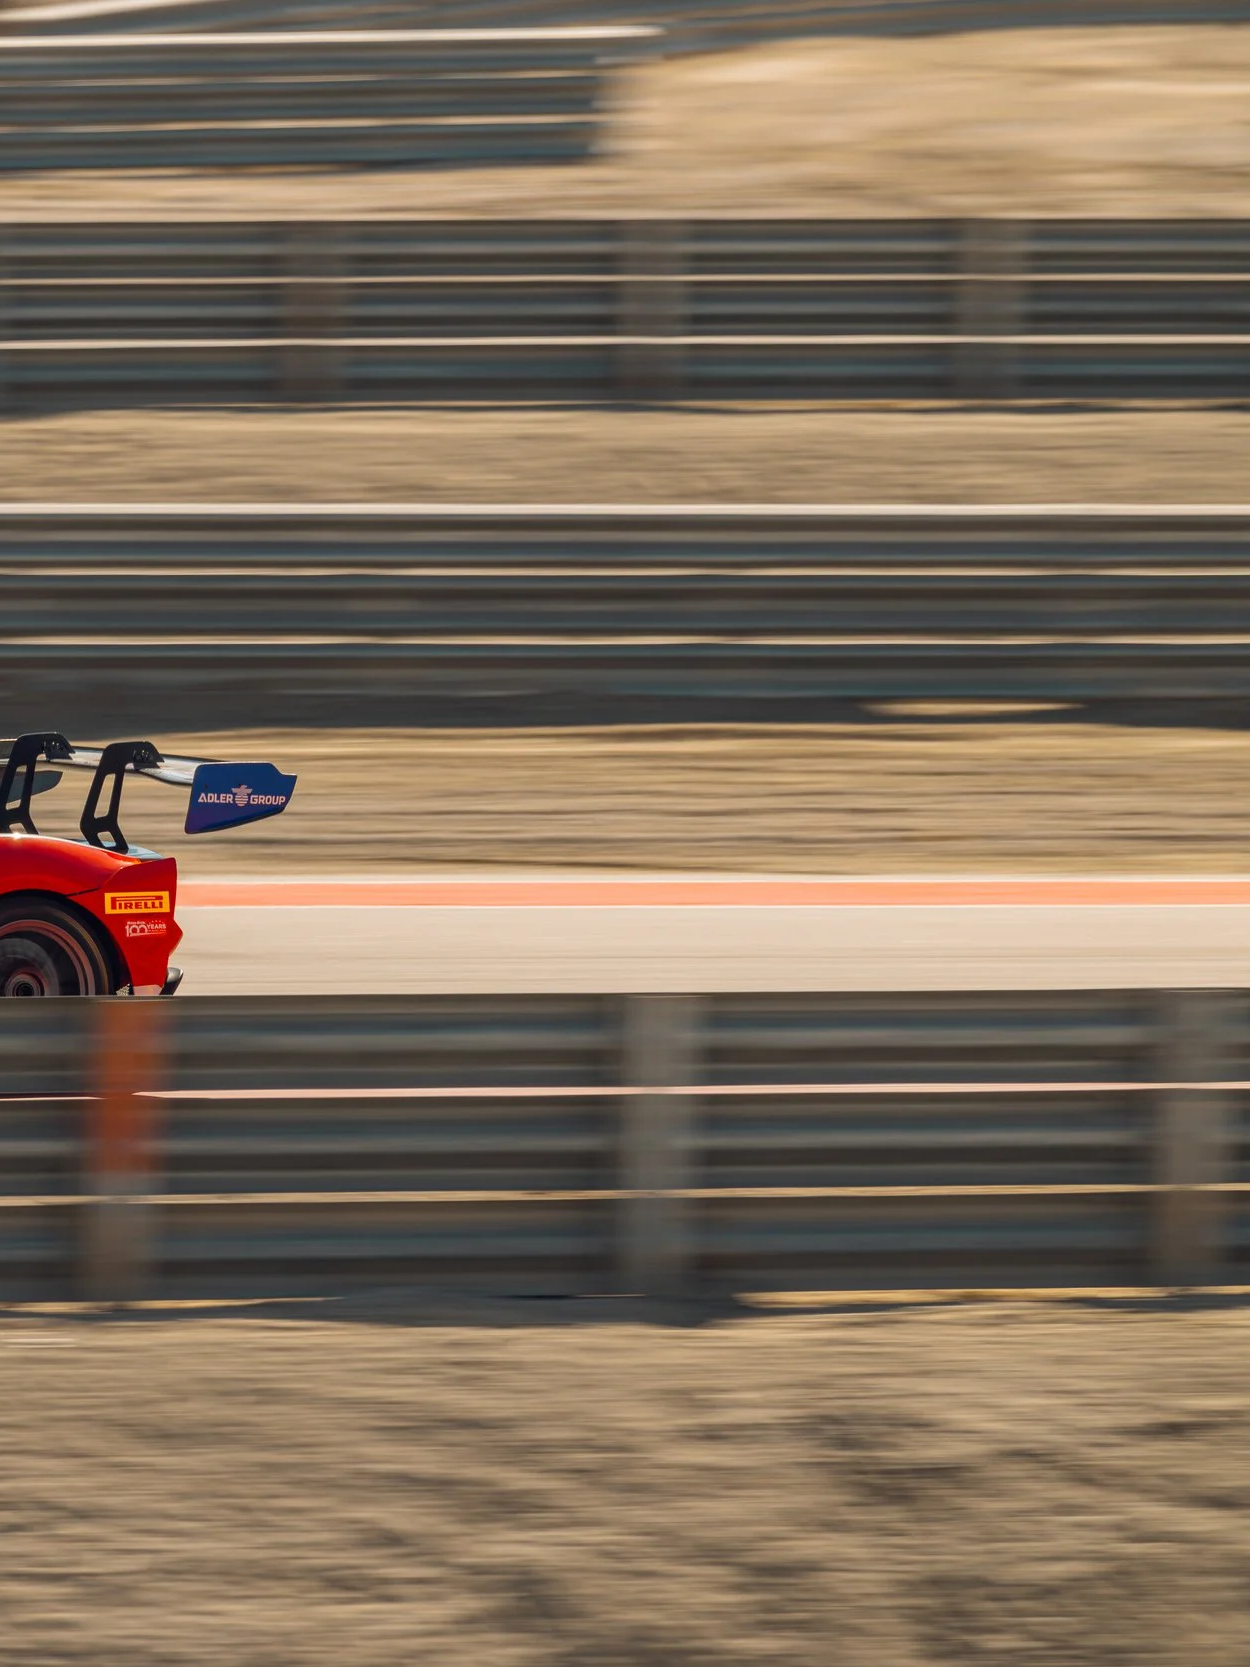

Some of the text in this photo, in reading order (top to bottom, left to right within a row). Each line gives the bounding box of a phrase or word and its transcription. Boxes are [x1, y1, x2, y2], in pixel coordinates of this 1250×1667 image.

[198, 792, 287, 806] ADLER GROUP
[111, 895, 164, 910] PIRELLI
